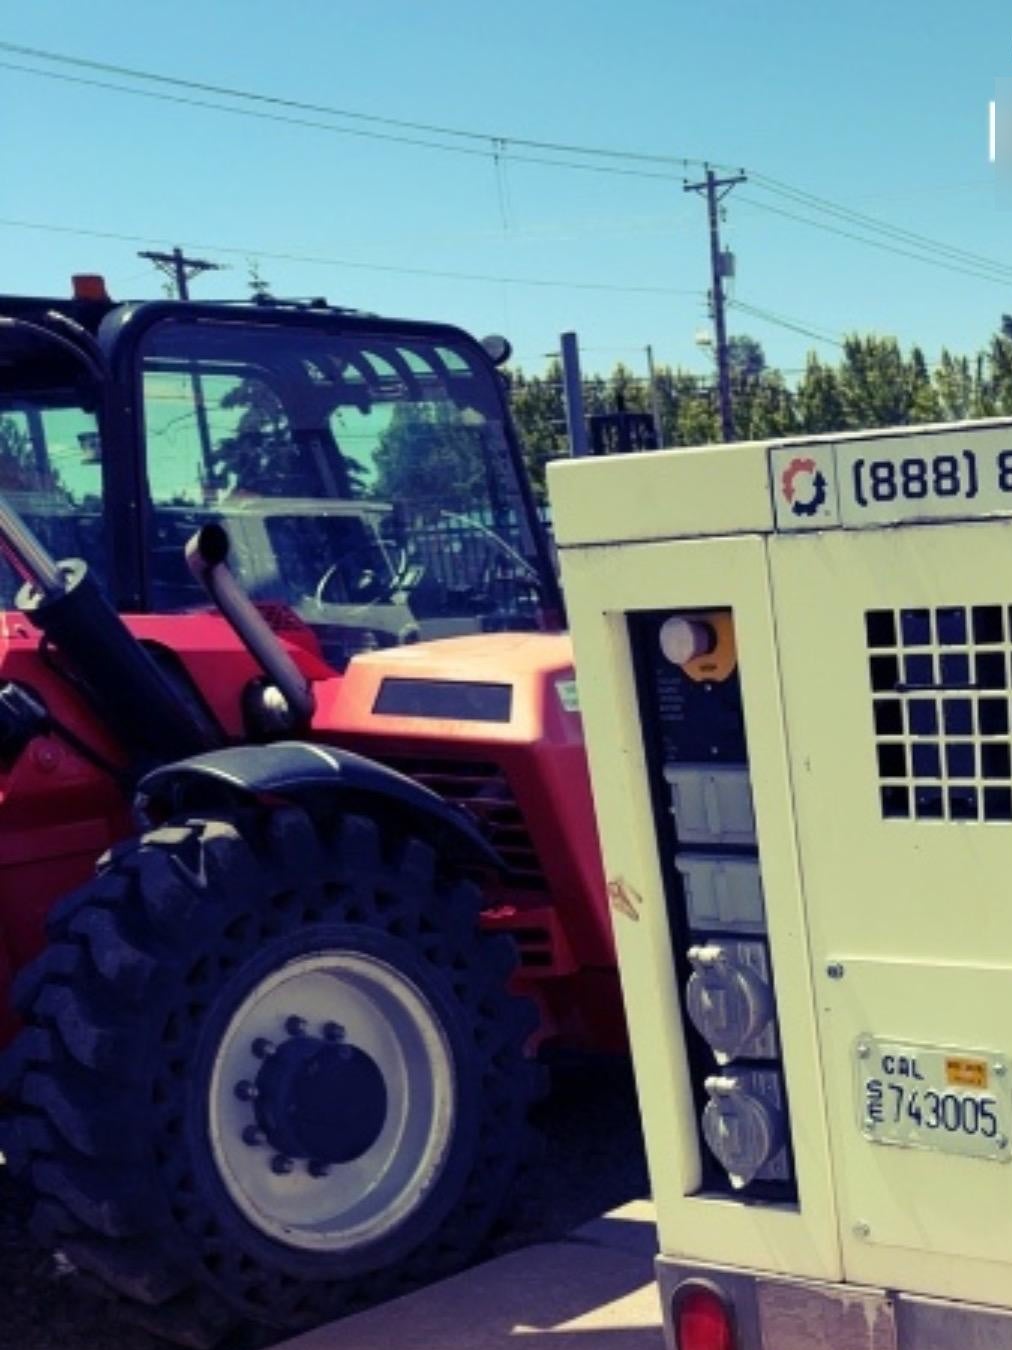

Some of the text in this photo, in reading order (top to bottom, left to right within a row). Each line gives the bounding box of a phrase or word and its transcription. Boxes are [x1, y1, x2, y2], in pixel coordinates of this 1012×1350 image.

[854, 449, 979, 508] (888)
[881, 1055, 925, 1081] CAL
[888, 1083, 997, 1138] 743005
